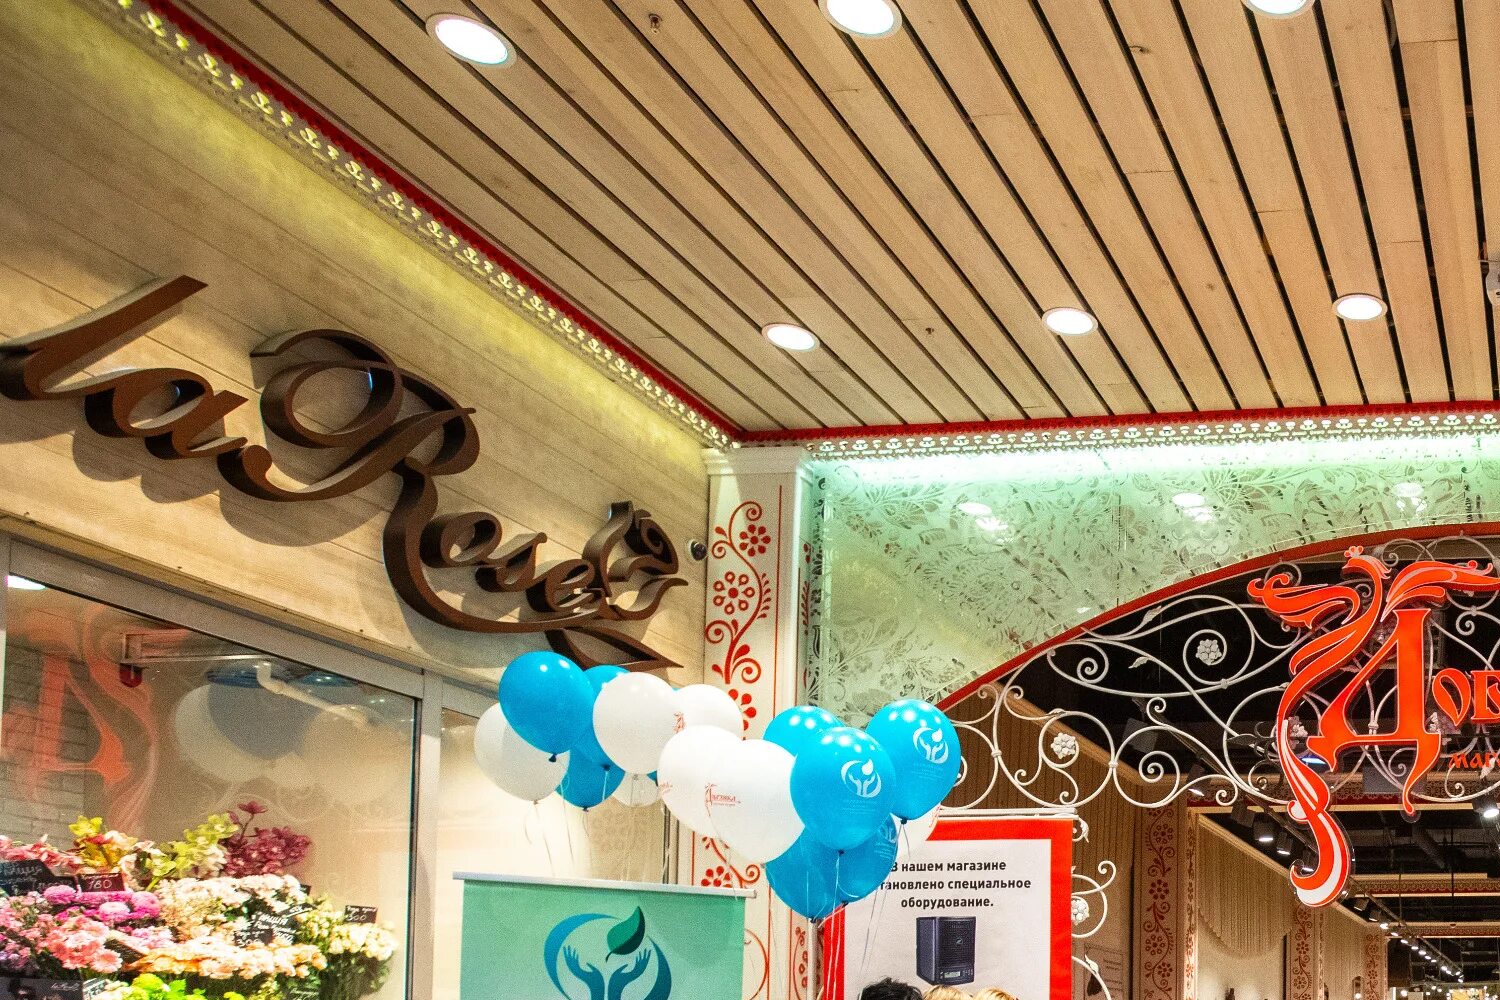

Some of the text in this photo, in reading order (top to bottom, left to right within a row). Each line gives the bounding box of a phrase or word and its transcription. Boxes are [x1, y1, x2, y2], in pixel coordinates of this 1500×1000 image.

[219, 328, 650, 638] Rose
[902, 861, 943, 872] нашем
[947, 860, 1006, 871] магазине
[880, 879, 1031, 890] тановлено специальное
[901, 897, 994, 910] оборудование.
